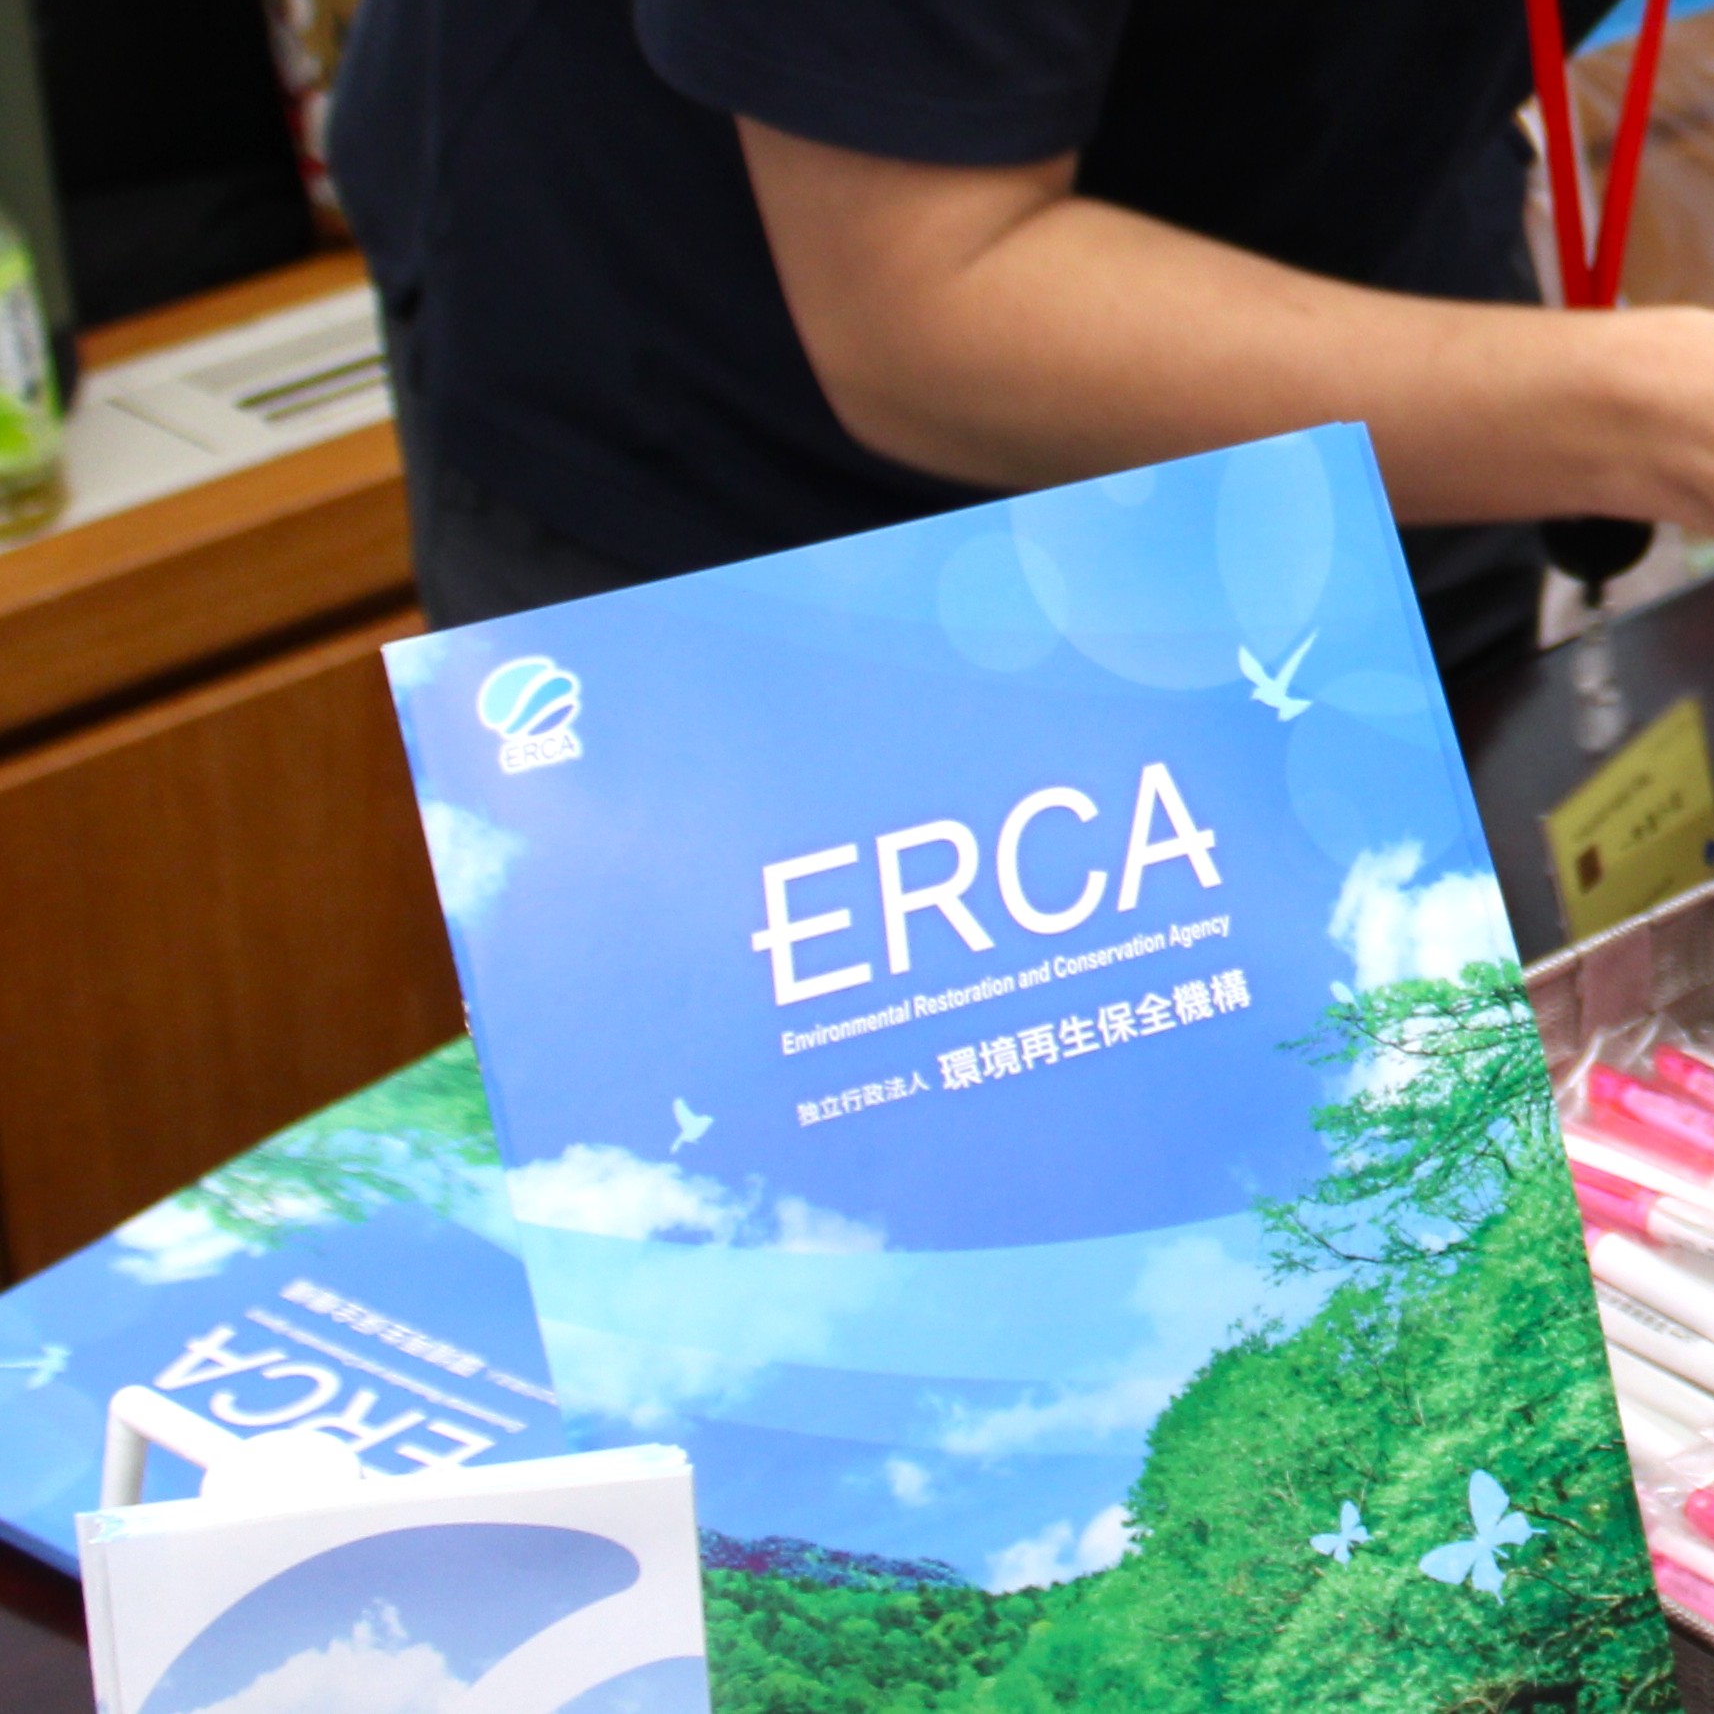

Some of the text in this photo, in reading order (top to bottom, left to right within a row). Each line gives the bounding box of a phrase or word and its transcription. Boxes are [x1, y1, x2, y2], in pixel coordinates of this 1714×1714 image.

[504, 734, 578, 768] ERCA
[751, 762, 1223, 1006] ERCA
[781, 914, 1232, 1056] Environmental Restoration and Conservation Agency
[796, 969, 1253, 1127] 独立行政法人 環境再生保全機構
